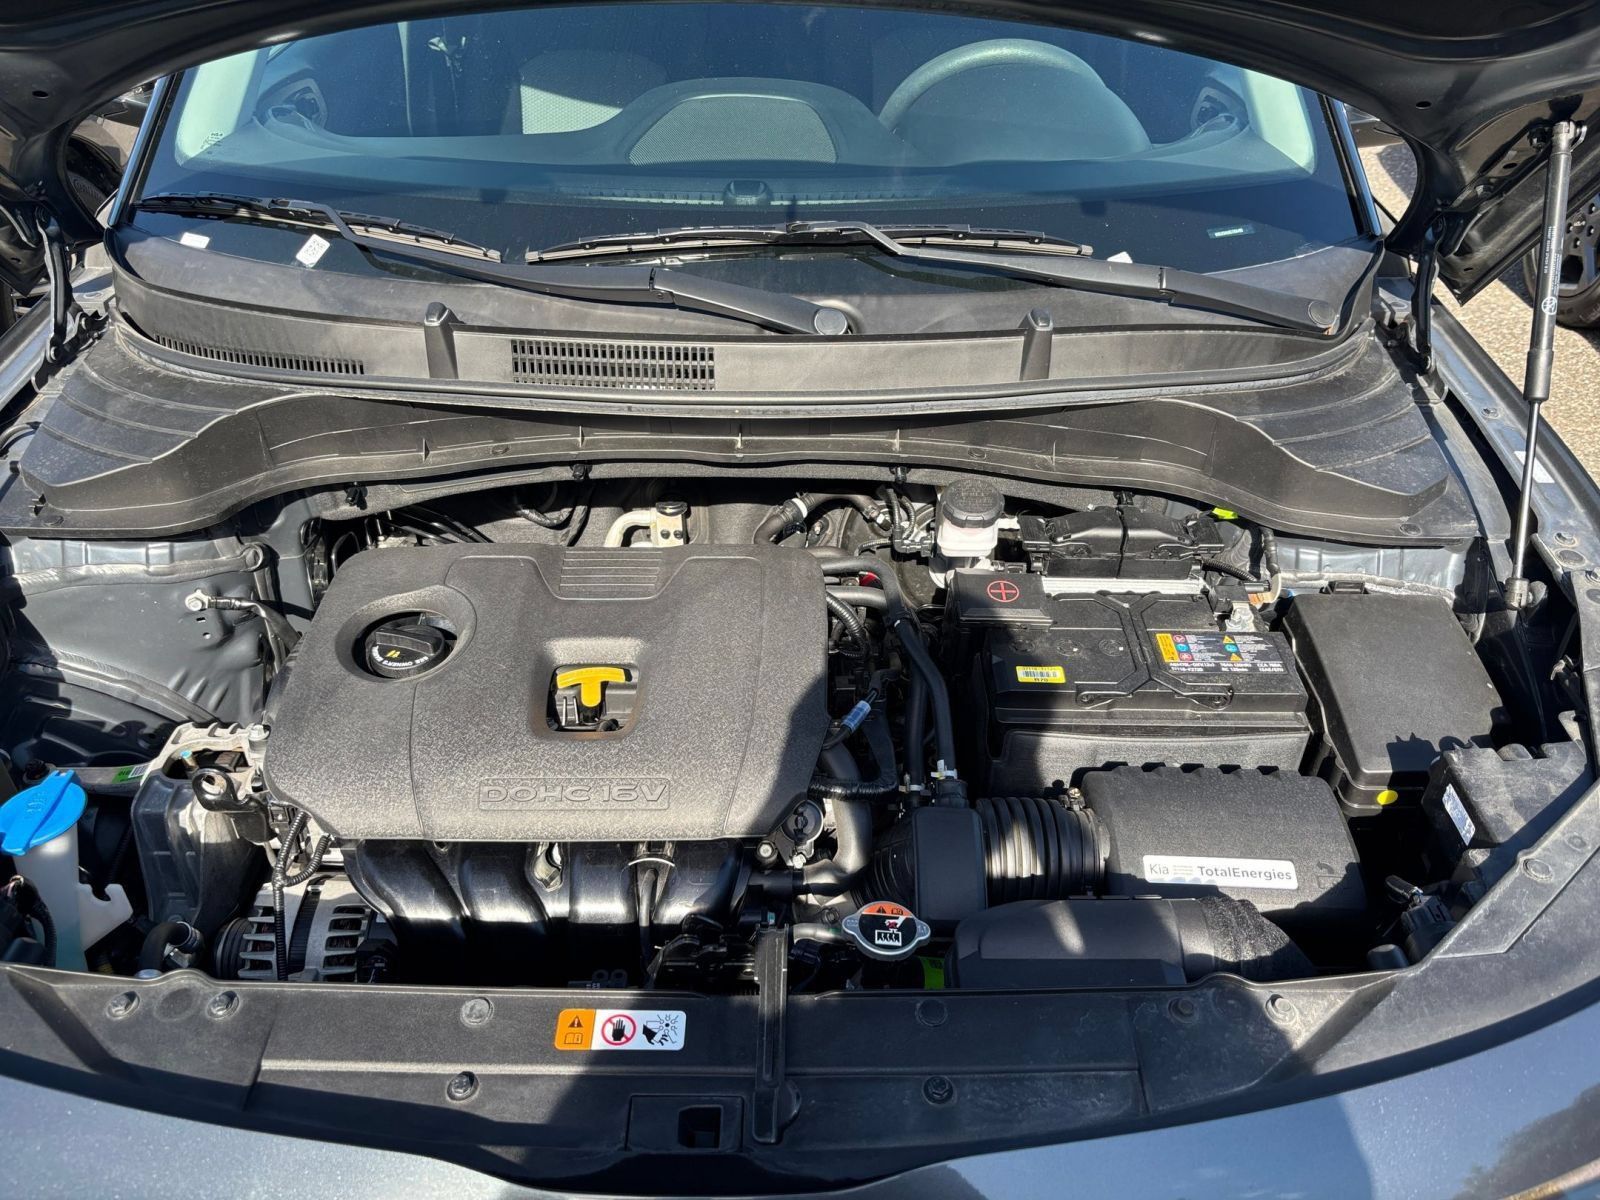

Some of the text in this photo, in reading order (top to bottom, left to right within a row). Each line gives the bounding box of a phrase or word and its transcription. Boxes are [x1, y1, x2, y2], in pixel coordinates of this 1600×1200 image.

[481, 784, 668, 803] DOHC 16V
[1149, 863, 1293, 881] Kia TotalEnergies
